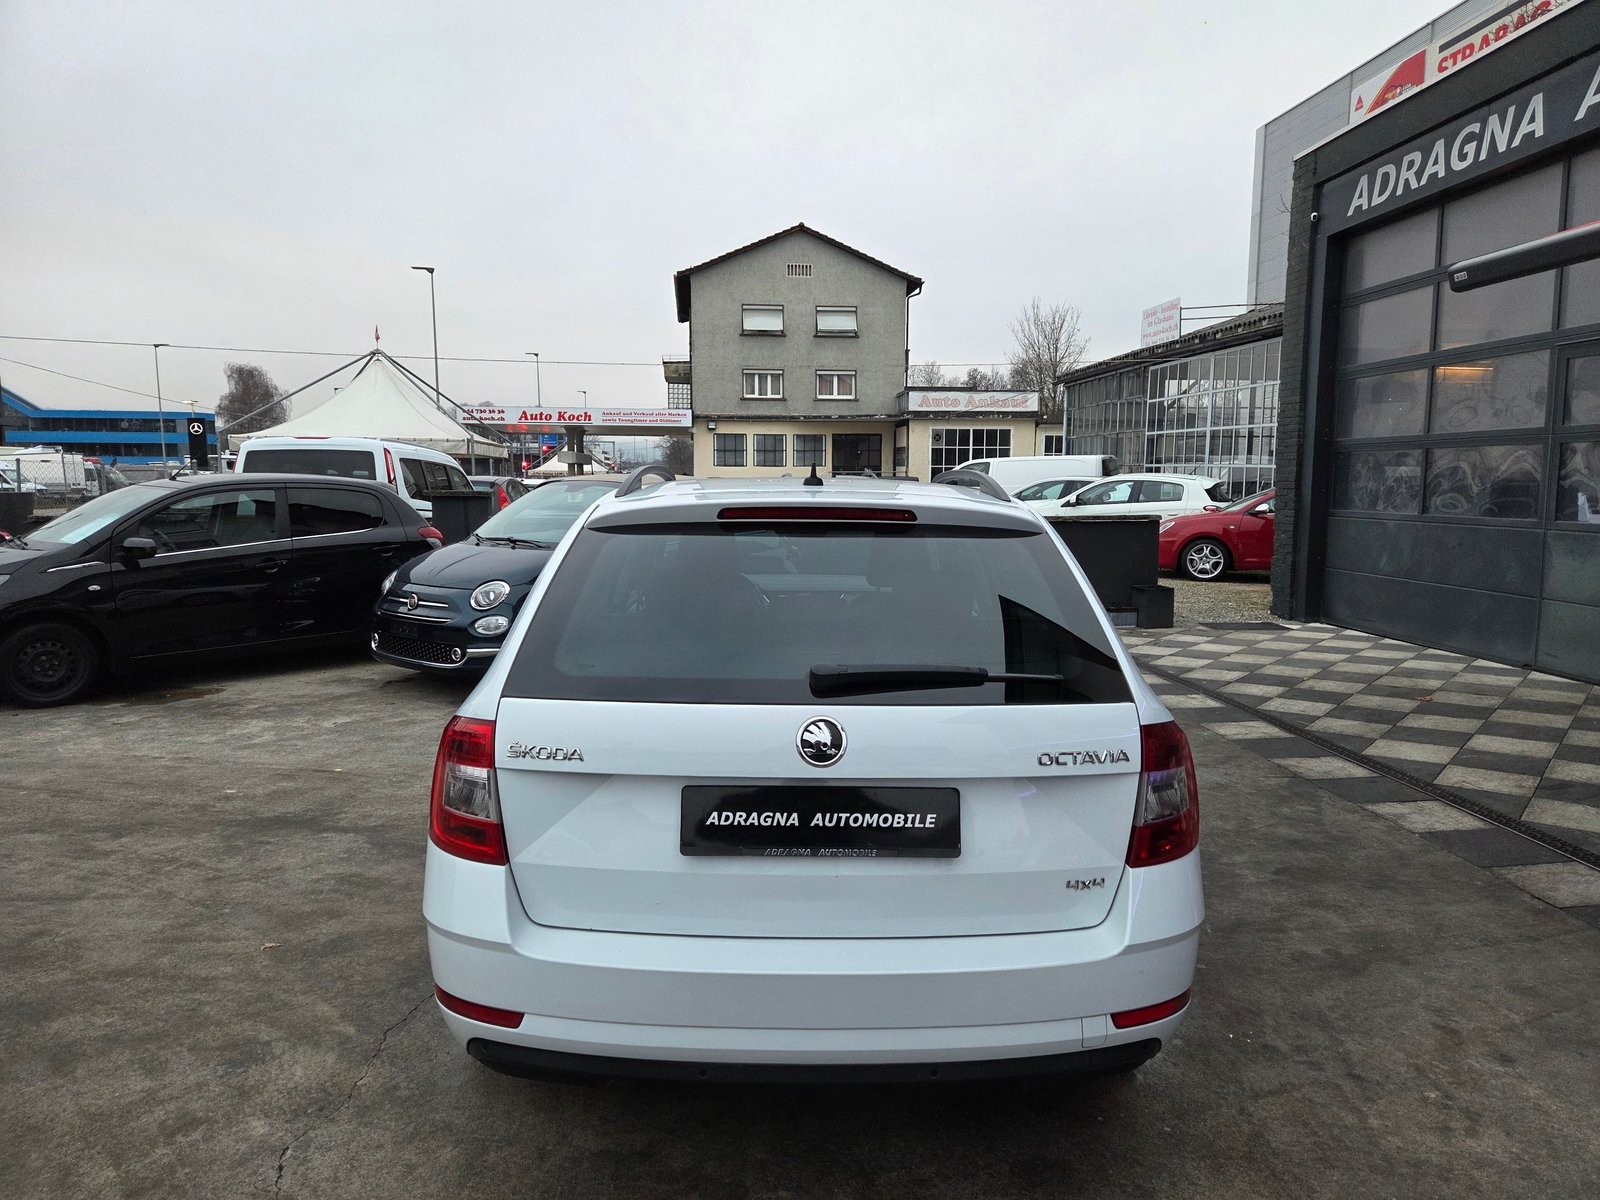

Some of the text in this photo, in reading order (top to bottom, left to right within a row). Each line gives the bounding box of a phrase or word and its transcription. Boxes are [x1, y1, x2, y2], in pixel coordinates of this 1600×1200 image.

[1347, 92, 1544, 217] ADRAGNA
[919, 395, 1030, 409] Auto Ankauf
[518, 410, 592, 422] Auto Koch
[507, 740, 584, 762] ŠKODA
[1037, 749, 1130, 766] OCTAVIA
[706, 812, 937, 828] ADRAGNA AUTOMOBILE
[765, 848, 877, 857] ADRAGNA AUTOMOBILE
